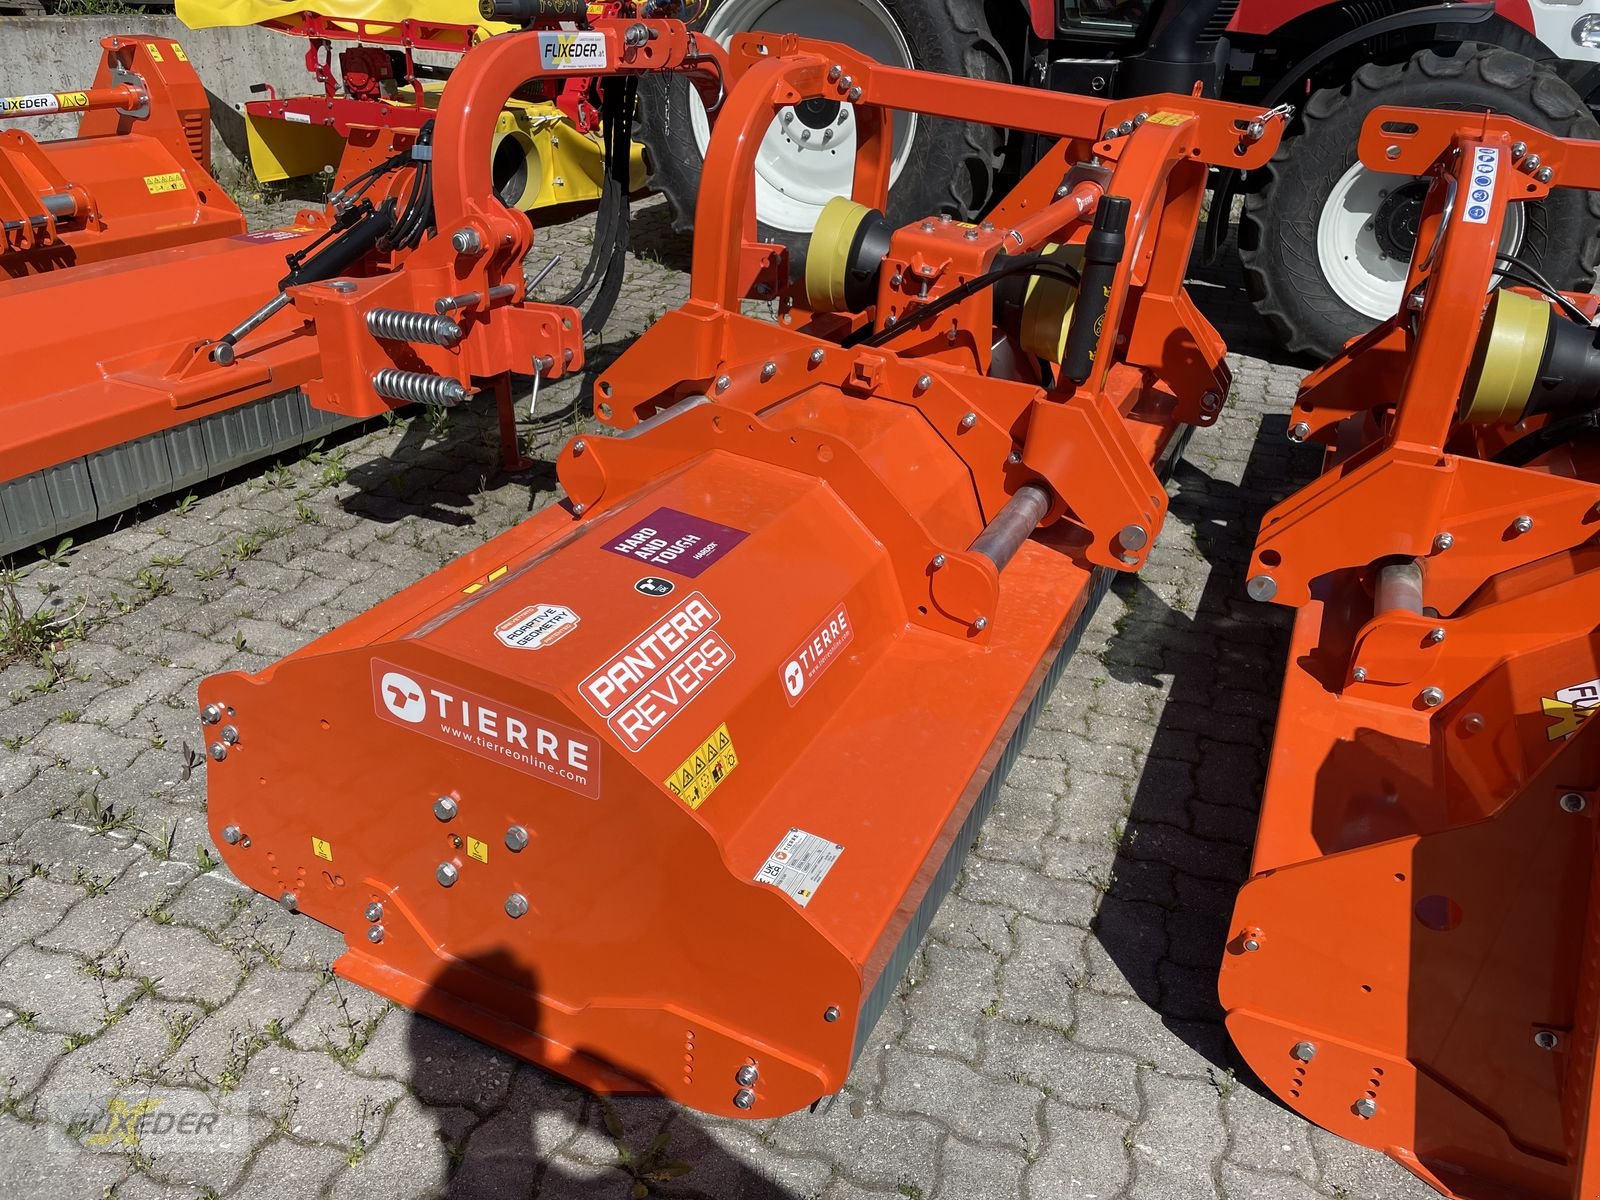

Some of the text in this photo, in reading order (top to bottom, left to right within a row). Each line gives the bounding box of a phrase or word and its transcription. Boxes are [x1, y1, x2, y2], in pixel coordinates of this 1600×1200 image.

[544, 43, 598, 58] FLIXEDER
[0, 98, 48, 111] LIXEDER
[614, 527, 657, 553] HARD
[634, 538, 668, 560] AND
[651, 534, 701, 565] TOUGH
[693, 541, 718, 560] HARDOX
[506, 608, 557, 640] ADAPTIVE
[516, 611, 568, 645] GEOMETRY
[588, 600, 713, 709] PANTERA
[799, 611, 847, 669] TIERRE
[616, 638, 727, 743] REVERS
[430, 689, 588, 771] TIERRE
[440, 723, 587, 786] www.tierreonline.com
[763, 863, 775, 874] UK
